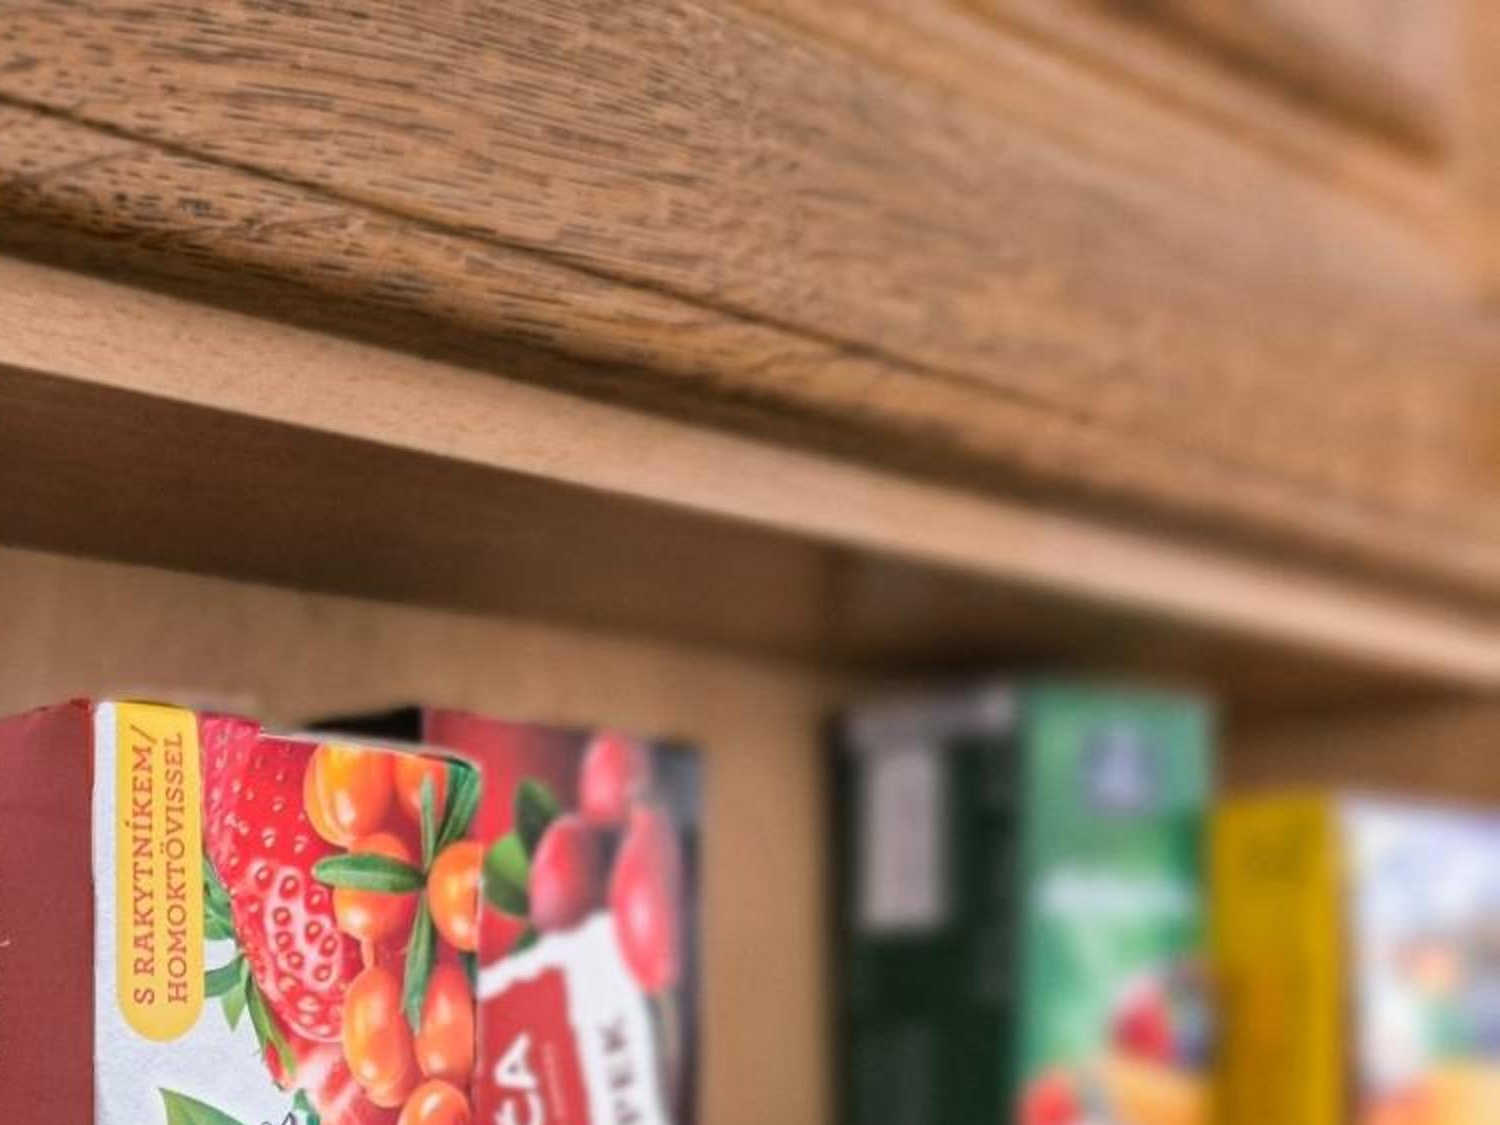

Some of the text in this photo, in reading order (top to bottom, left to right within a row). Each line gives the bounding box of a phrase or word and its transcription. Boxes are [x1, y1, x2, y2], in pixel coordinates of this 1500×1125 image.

[124, 724, 157, 1005] S RAKYTNÍKEM/
[160, 732, 187, 1004] HOMOKTÖVISSEL
